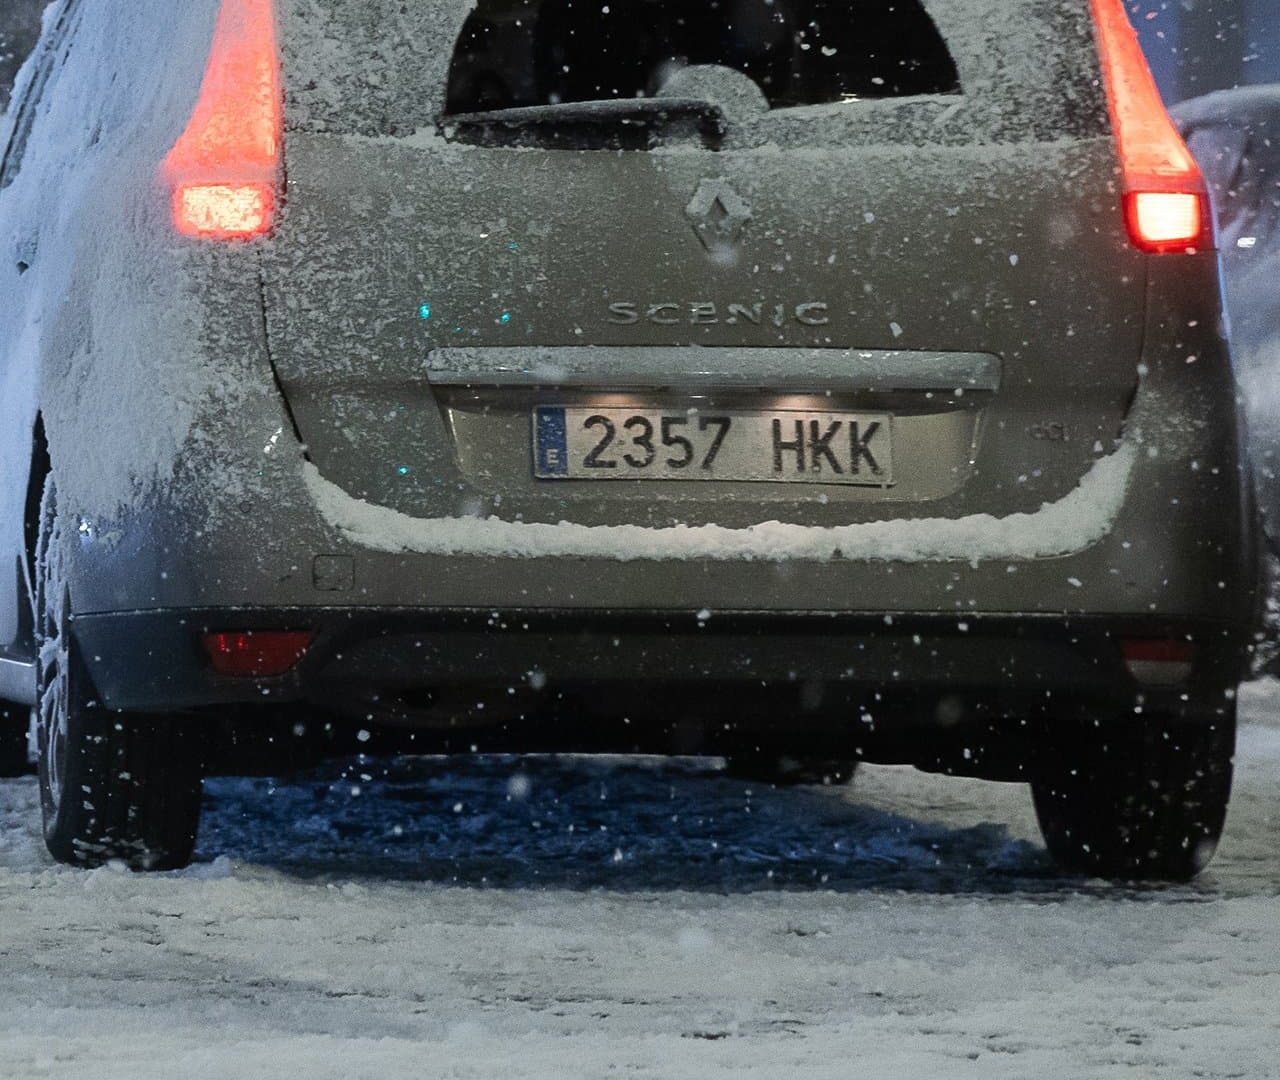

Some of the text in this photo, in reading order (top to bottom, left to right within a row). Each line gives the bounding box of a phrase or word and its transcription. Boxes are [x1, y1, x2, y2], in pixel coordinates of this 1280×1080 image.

[607, 301, 829, 326] SCENIC
[546, 414, 884, 476] E 2357 HKK
